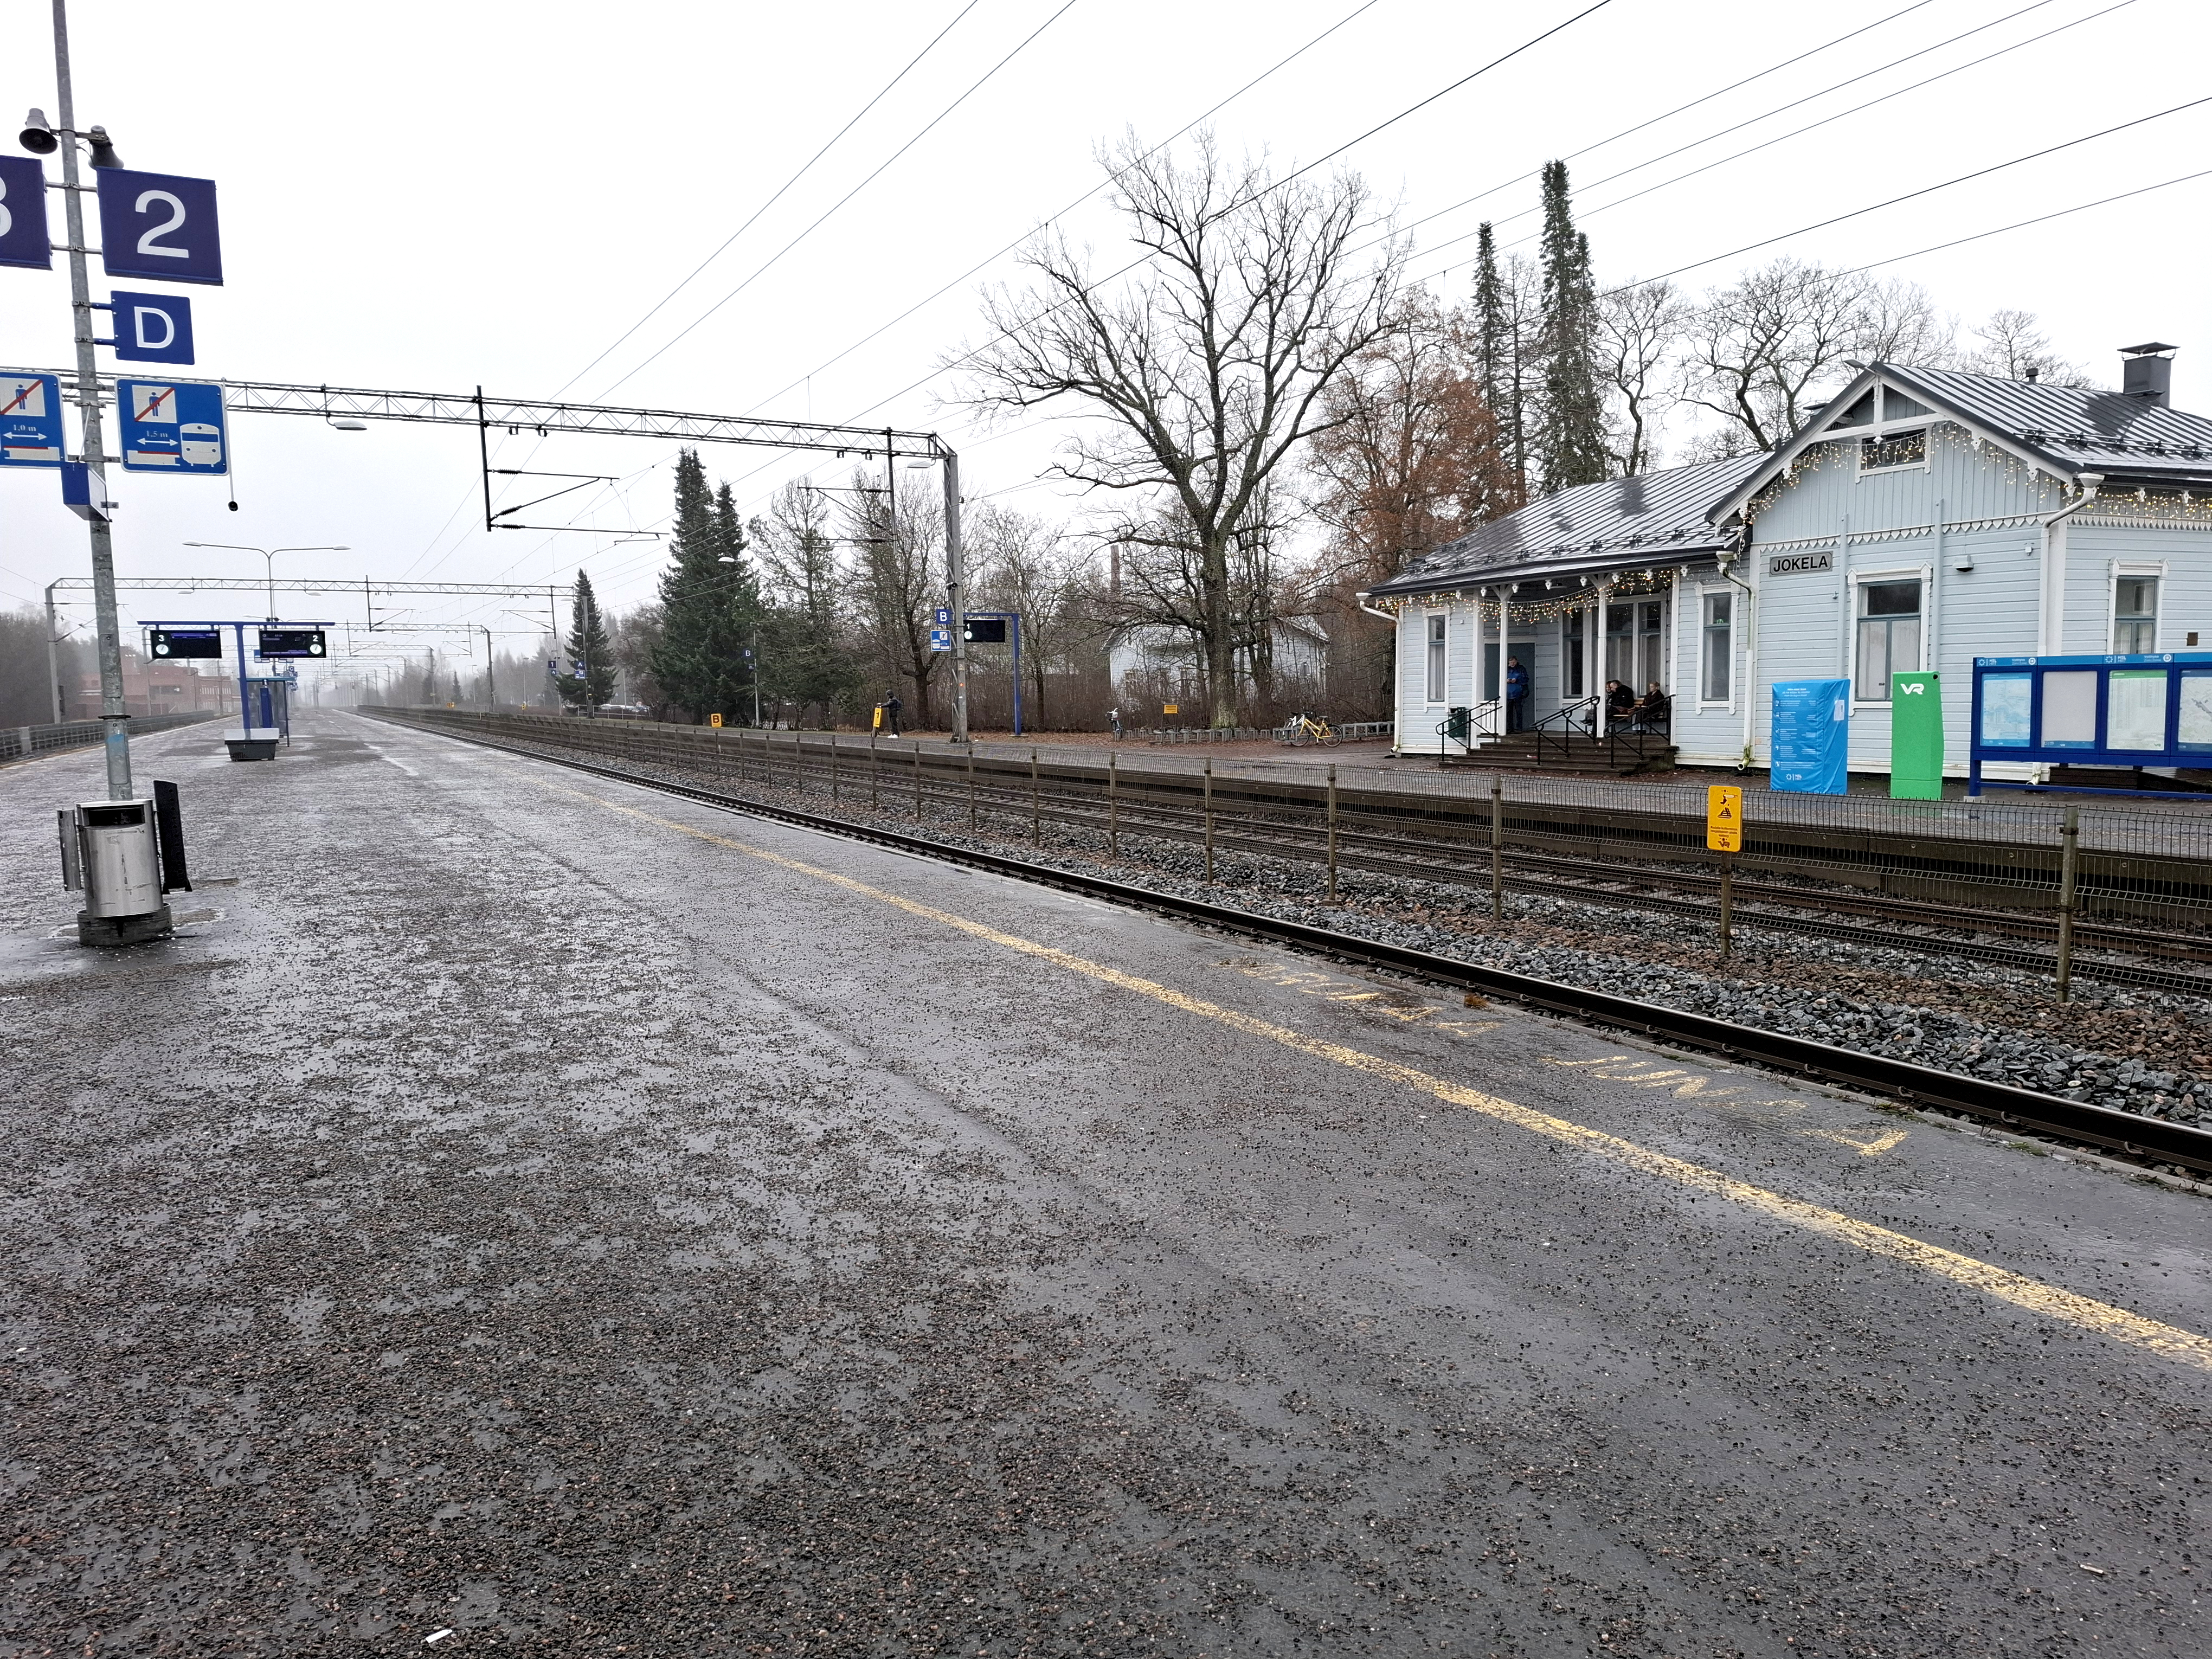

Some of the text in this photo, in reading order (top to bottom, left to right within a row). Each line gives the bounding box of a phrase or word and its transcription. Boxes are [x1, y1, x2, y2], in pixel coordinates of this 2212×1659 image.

[136, 190, 189, 258] 2
[134, 306, 174, 349] D
[1773, 555, 1828, 573] JOKELA
[940, 612, 947, 621] B
[1900, 683, 1925, 695] VR
[712, 715, 720, 723] B
[1718, 840, 1731, 848] VR
